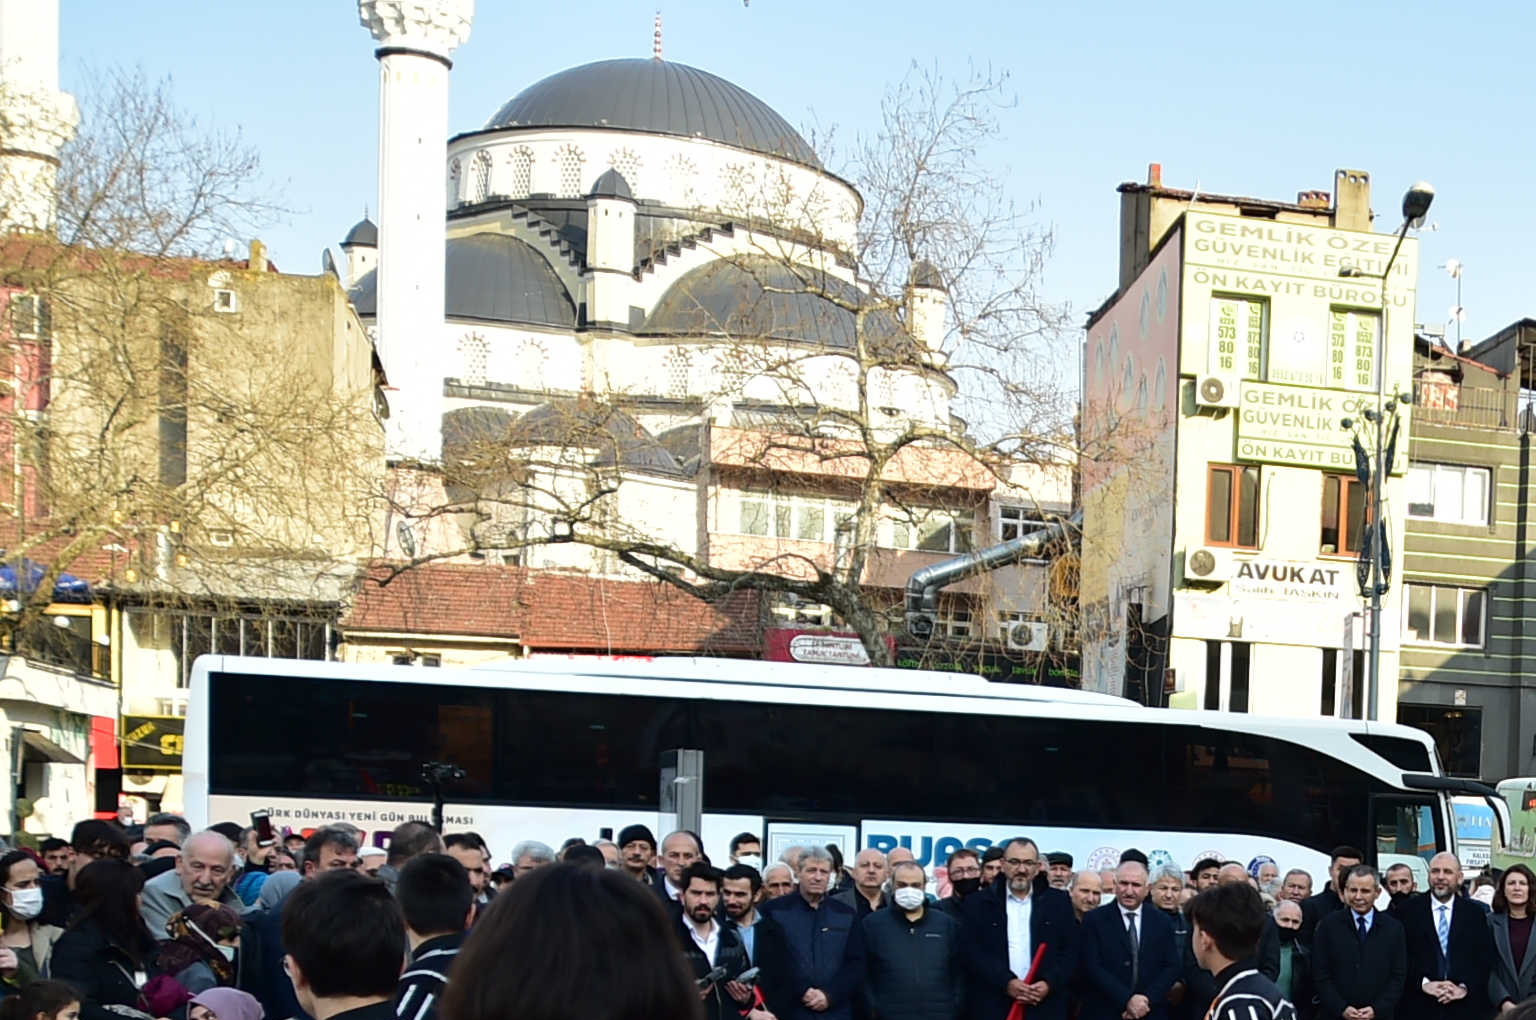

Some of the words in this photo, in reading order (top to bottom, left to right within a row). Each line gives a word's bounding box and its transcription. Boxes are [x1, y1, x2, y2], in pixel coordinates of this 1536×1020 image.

[1195, 219, 1315, 247] GEMLİK
[1194, 237, 1315, 265] GÜVENLİK
[1193, 267, 1227, 287] ÖN
[1236, 275, 1306, 296] KAYIT
[1217, 325, 1236, 340] 573
[1218, 340, 1234, 354] 80
[1331, 333, 1345, 348] 573
[1332, 349, 1344, 364] 80
[1355, 344, 1373, 358] 873
[1219, 355, 1233, 369] 16
[1248, 361, 1258, 374] 16
[1356, 358, 1371, 372] 80
[1332, 366, 1342, 380] 16
[1356, 372, 1369, 385] 16
[1244, 389, 1333, 412] GEMLİK
[1243, 407, 1333, 432] GÜVENLİK
[1241, 440, 1267, 457] ÖN
[1273, 446, 1325, 463] KAYIT
[1236, 562, 1340, 586] AVUKAT
[267, 806, 291, 819] ÜRK
[294, 808, 346, 820] DÜNYASI
[349, 810, 377, 821] YENİ
[380, 811, 405, 823] GÜN
